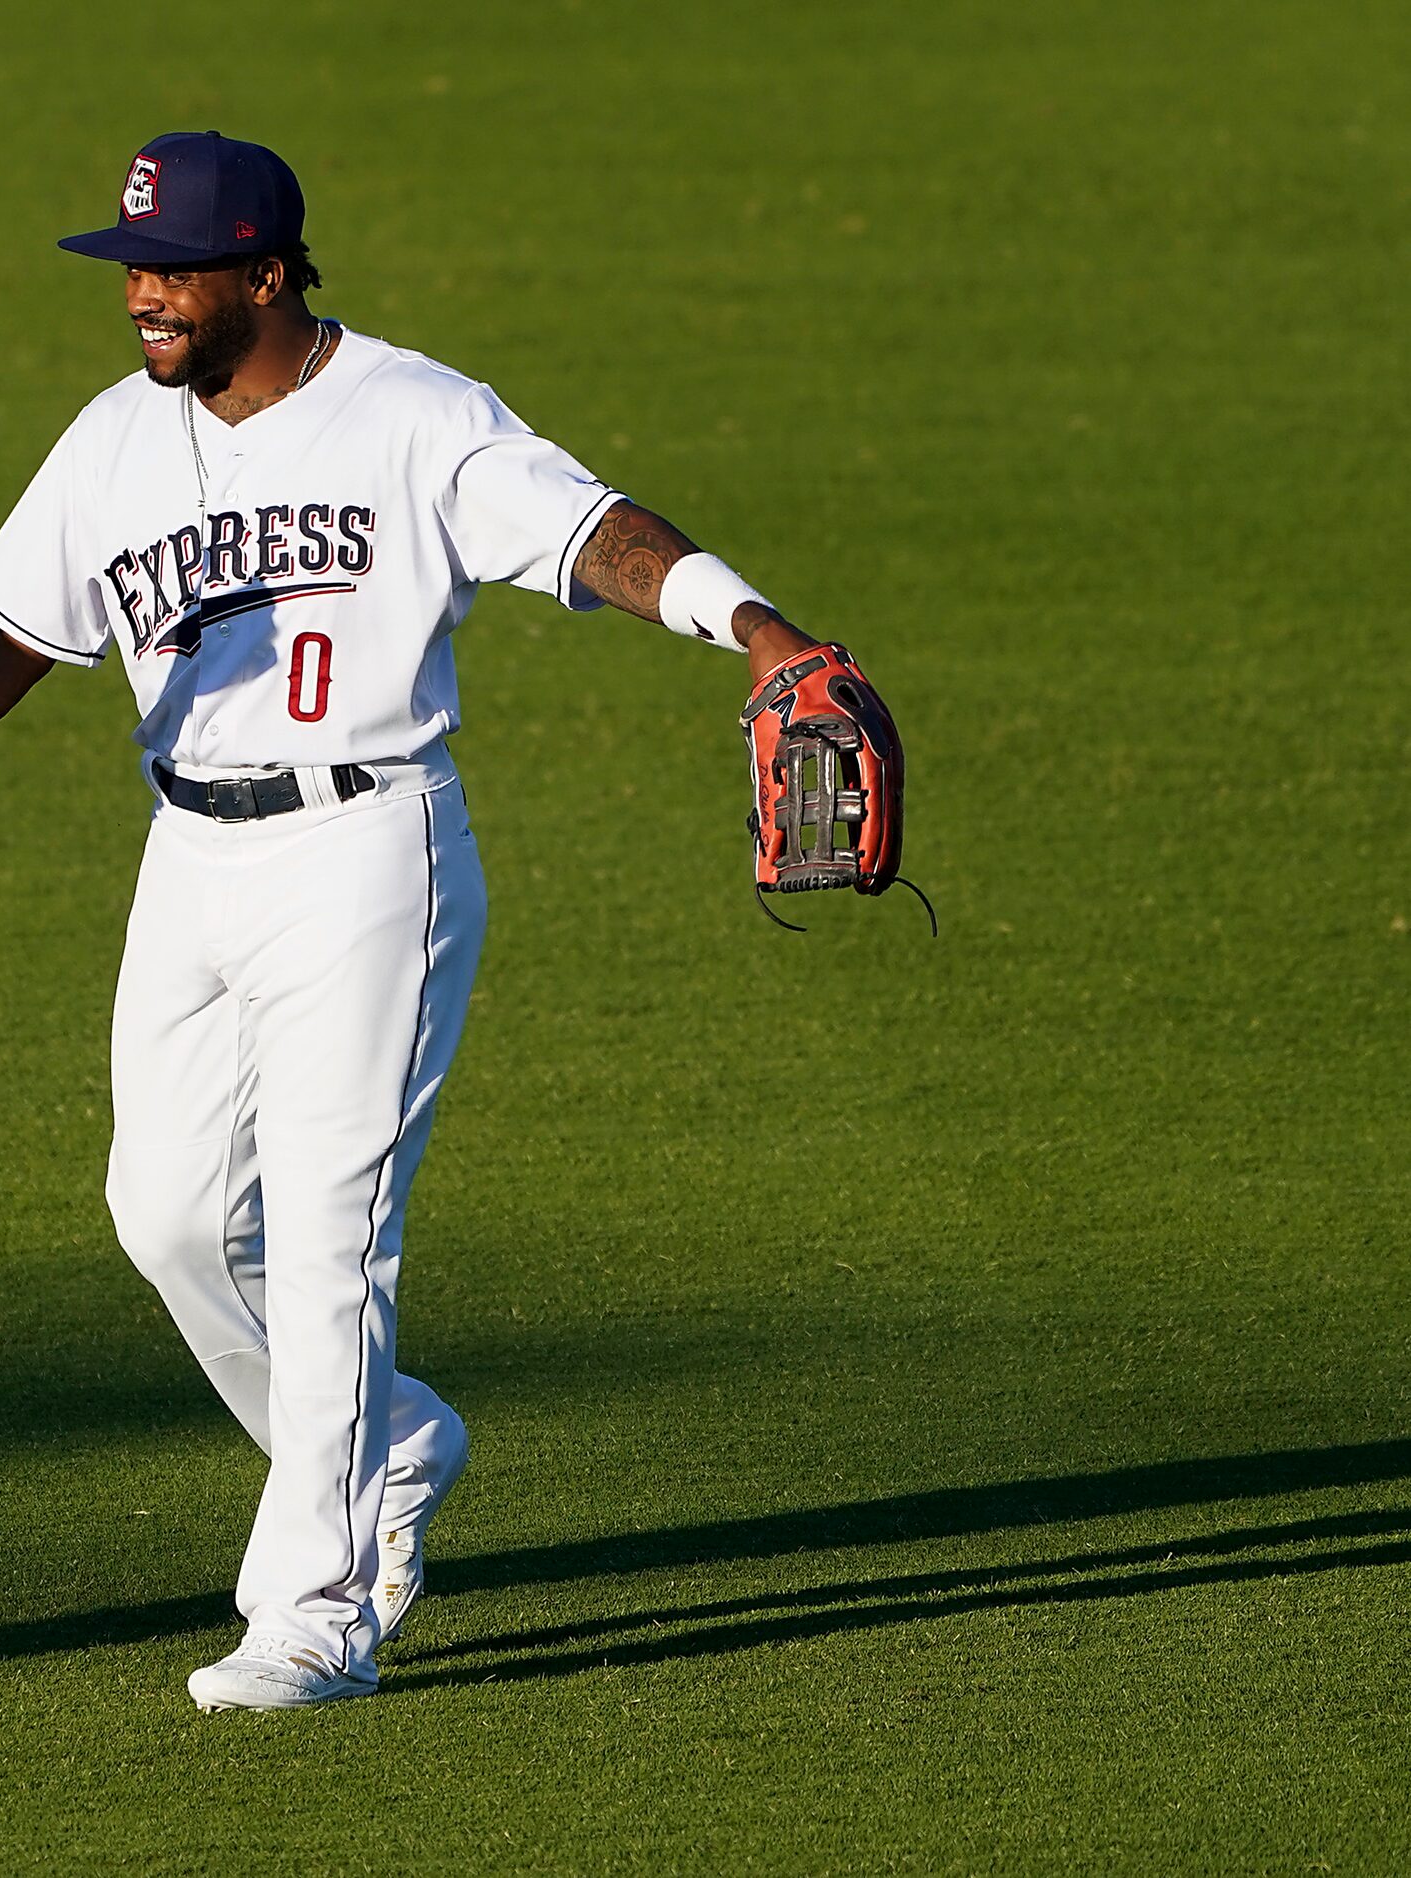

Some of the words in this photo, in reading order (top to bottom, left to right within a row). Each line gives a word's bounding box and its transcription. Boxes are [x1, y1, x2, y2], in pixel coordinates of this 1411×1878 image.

[104, 504, 376, 660] EXPRESS
[287, 631, 333, 722] 0
[389, 1582, 409, 1610] adidas
